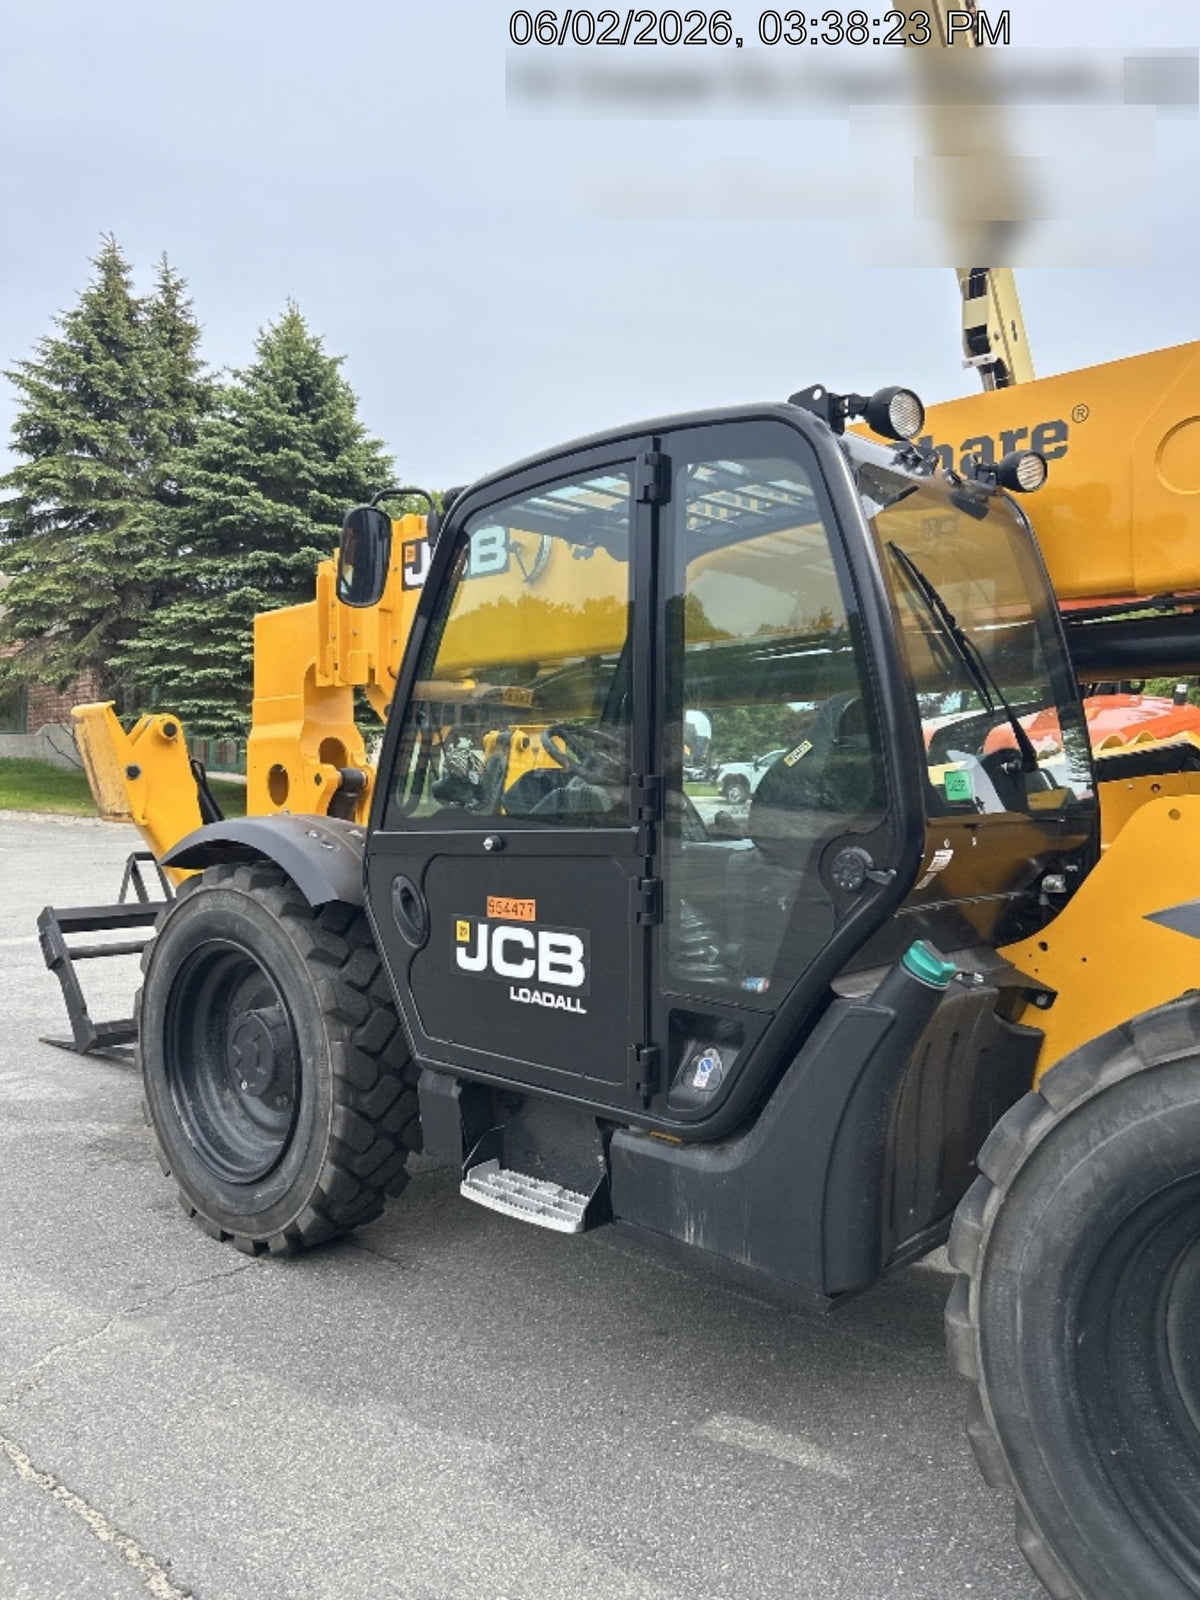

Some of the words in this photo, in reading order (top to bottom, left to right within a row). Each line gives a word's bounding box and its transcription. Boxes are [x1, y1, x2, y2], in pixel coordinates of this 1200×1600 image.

[404, 525, 509, 586] JB
[456, 922, 585, 987] JCB
[509, 986, 587, 1014] LOADALL
